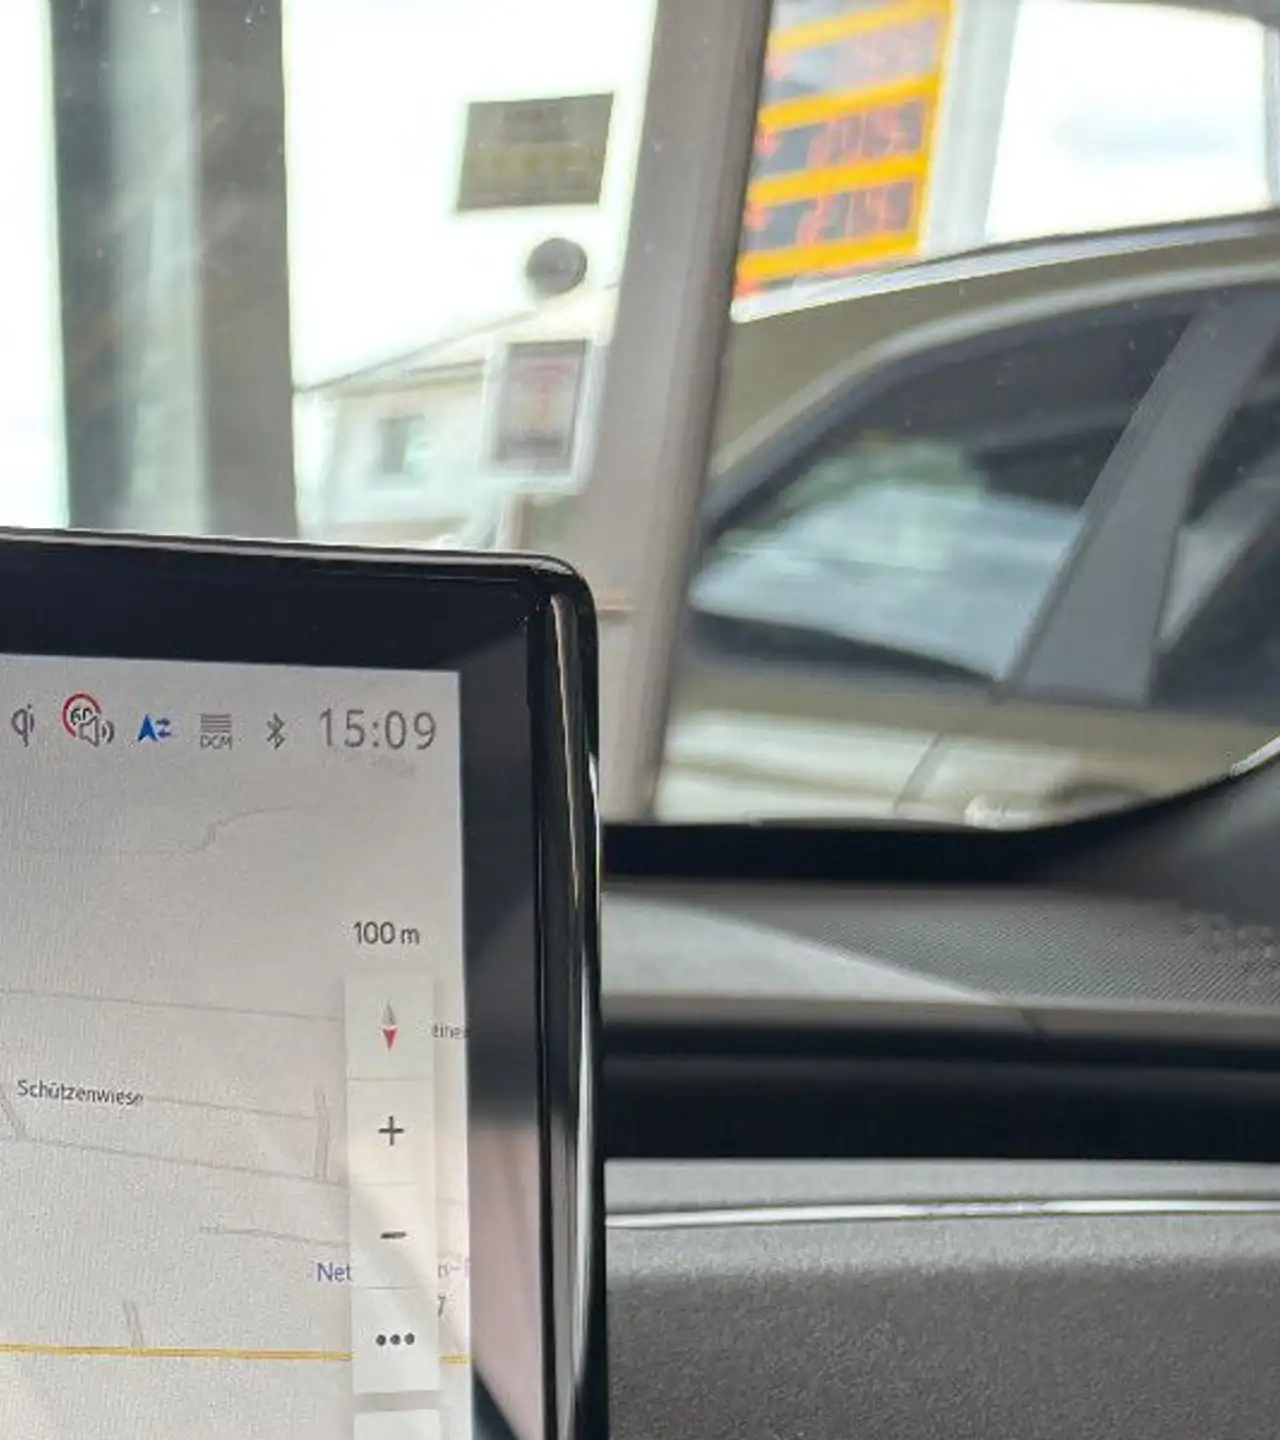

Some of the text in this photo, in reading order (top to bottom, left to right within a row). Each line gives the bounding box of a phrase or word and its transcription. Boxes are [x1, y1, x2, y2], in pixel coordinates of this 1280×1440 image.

[320, 707, 438, 750] 15:09
[200, 735, 233, 750] DCM
[354, 922, 420, 945] 100 m
[17, 1079, 144, 1106] Schützenwiese
